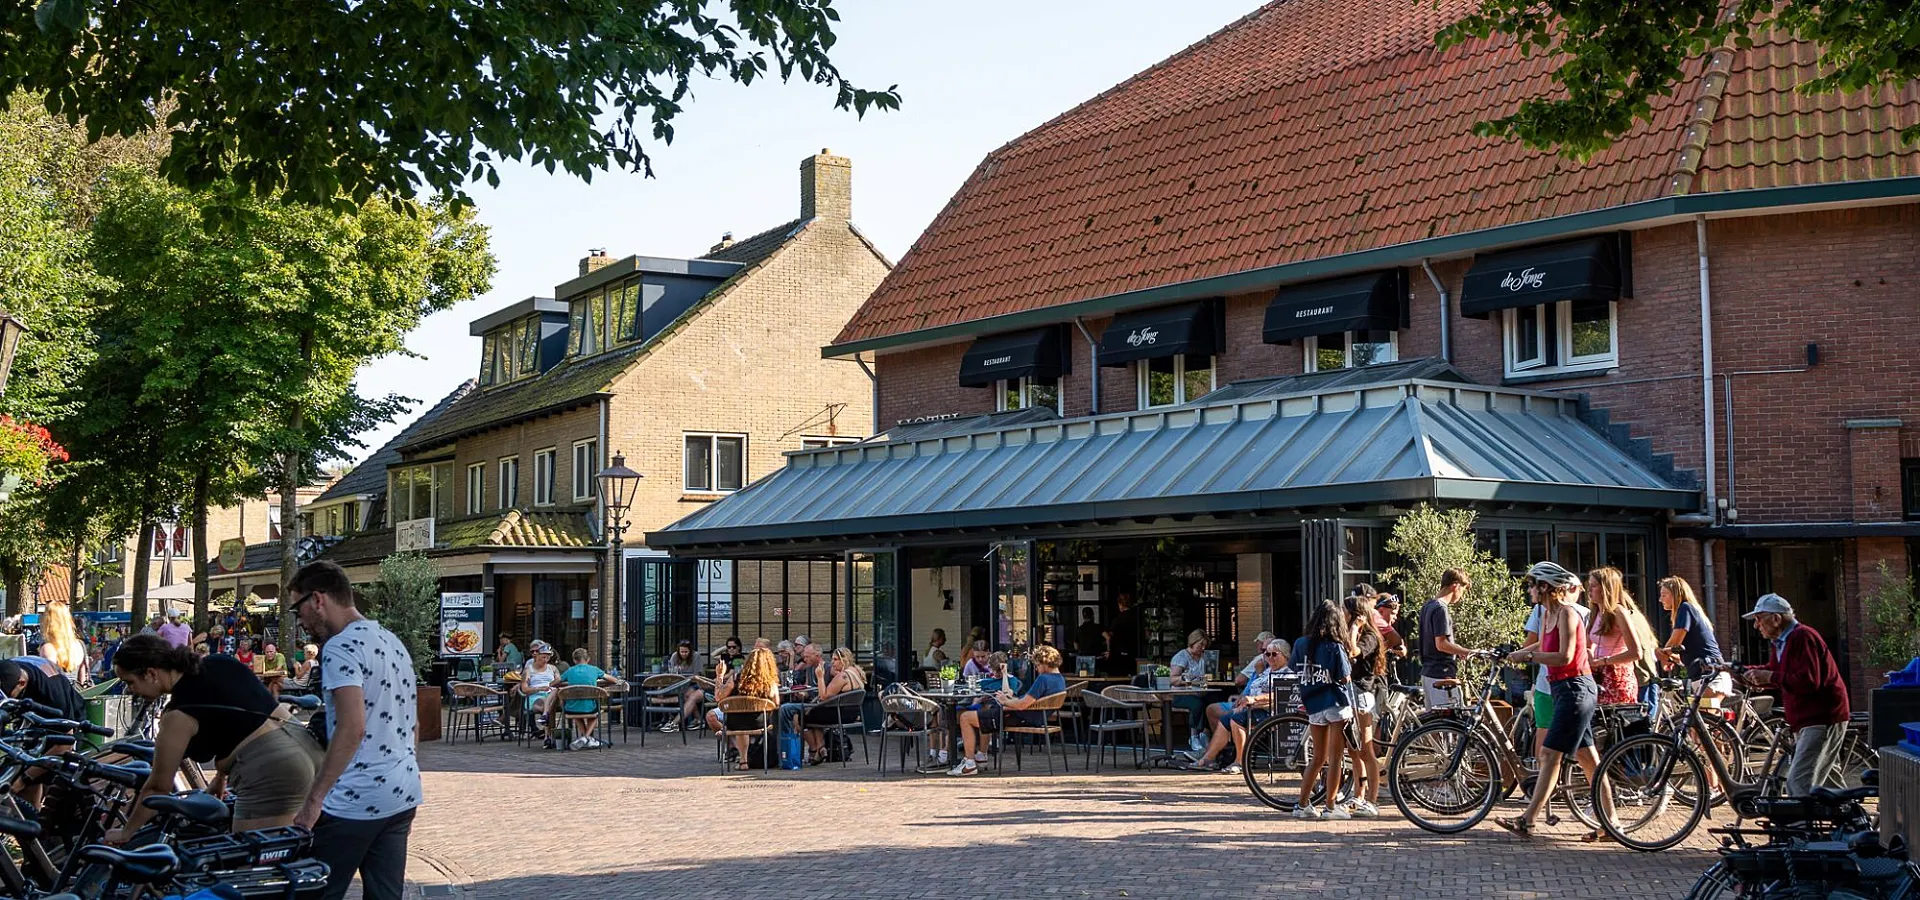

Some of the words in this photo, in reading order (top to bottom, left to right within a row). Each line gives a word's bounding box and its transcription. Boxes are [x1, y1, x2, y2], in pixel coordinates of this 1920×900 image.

[1500, 272, 1513, 288] de
[1511, 267, 1546, 291] Jong
[1295, 305, 1334, 318] RESTAURANT
[983, 355, 1011, 366] RESTAURANT
[470, 596, 481, 604] VIS
